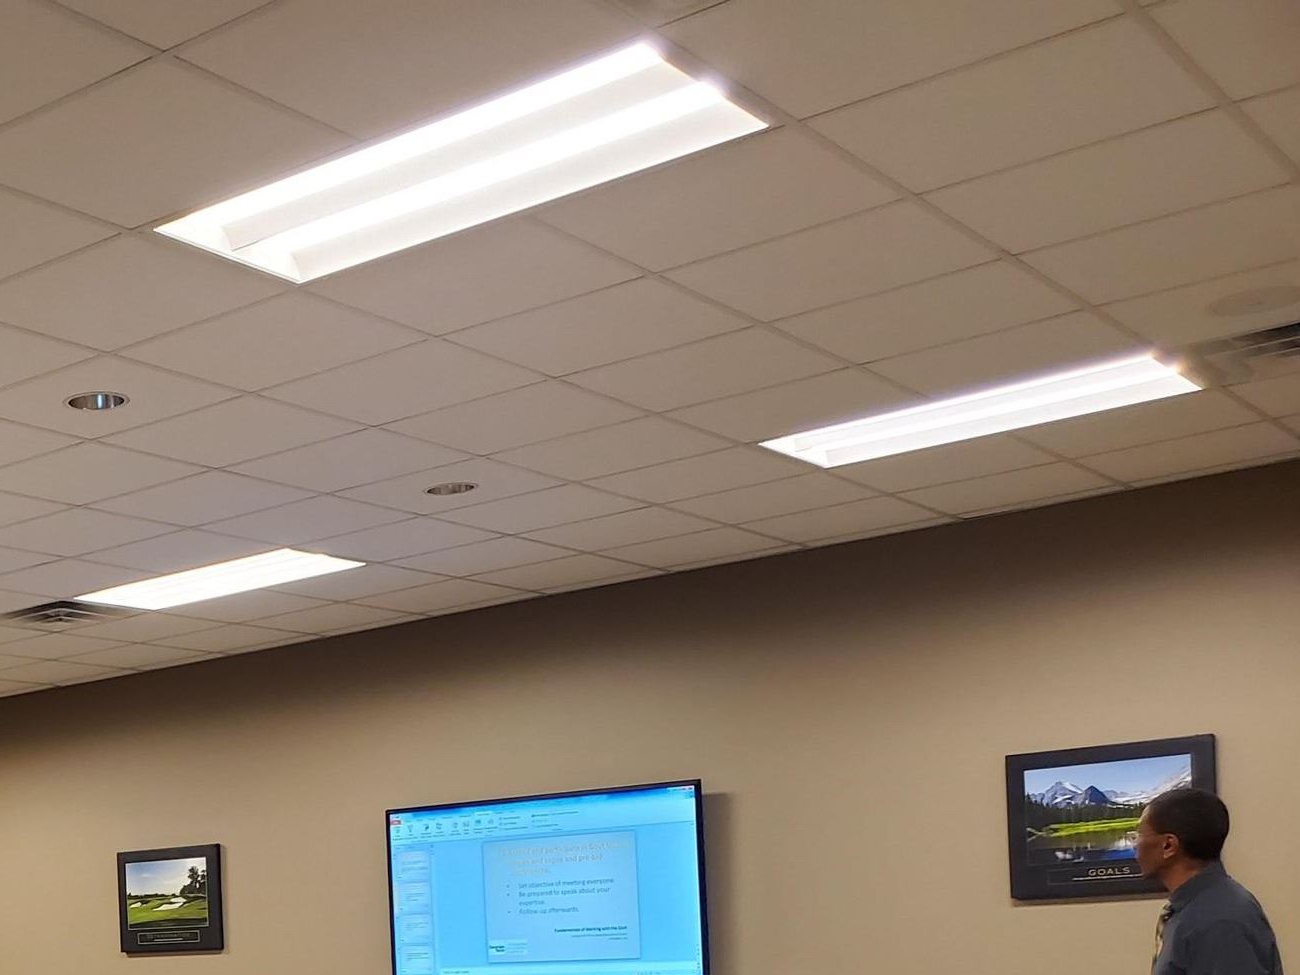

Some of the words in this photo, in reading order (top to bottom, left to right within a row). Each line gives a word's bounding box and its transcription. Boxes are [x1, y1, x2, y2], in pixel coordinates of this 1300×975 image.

[1088, 866, 1131, 876] GOALS
[562, 879, 586, 887] meeting
[527, 889, 553, 898] prepared
[561, 888, 577, 896] speak
